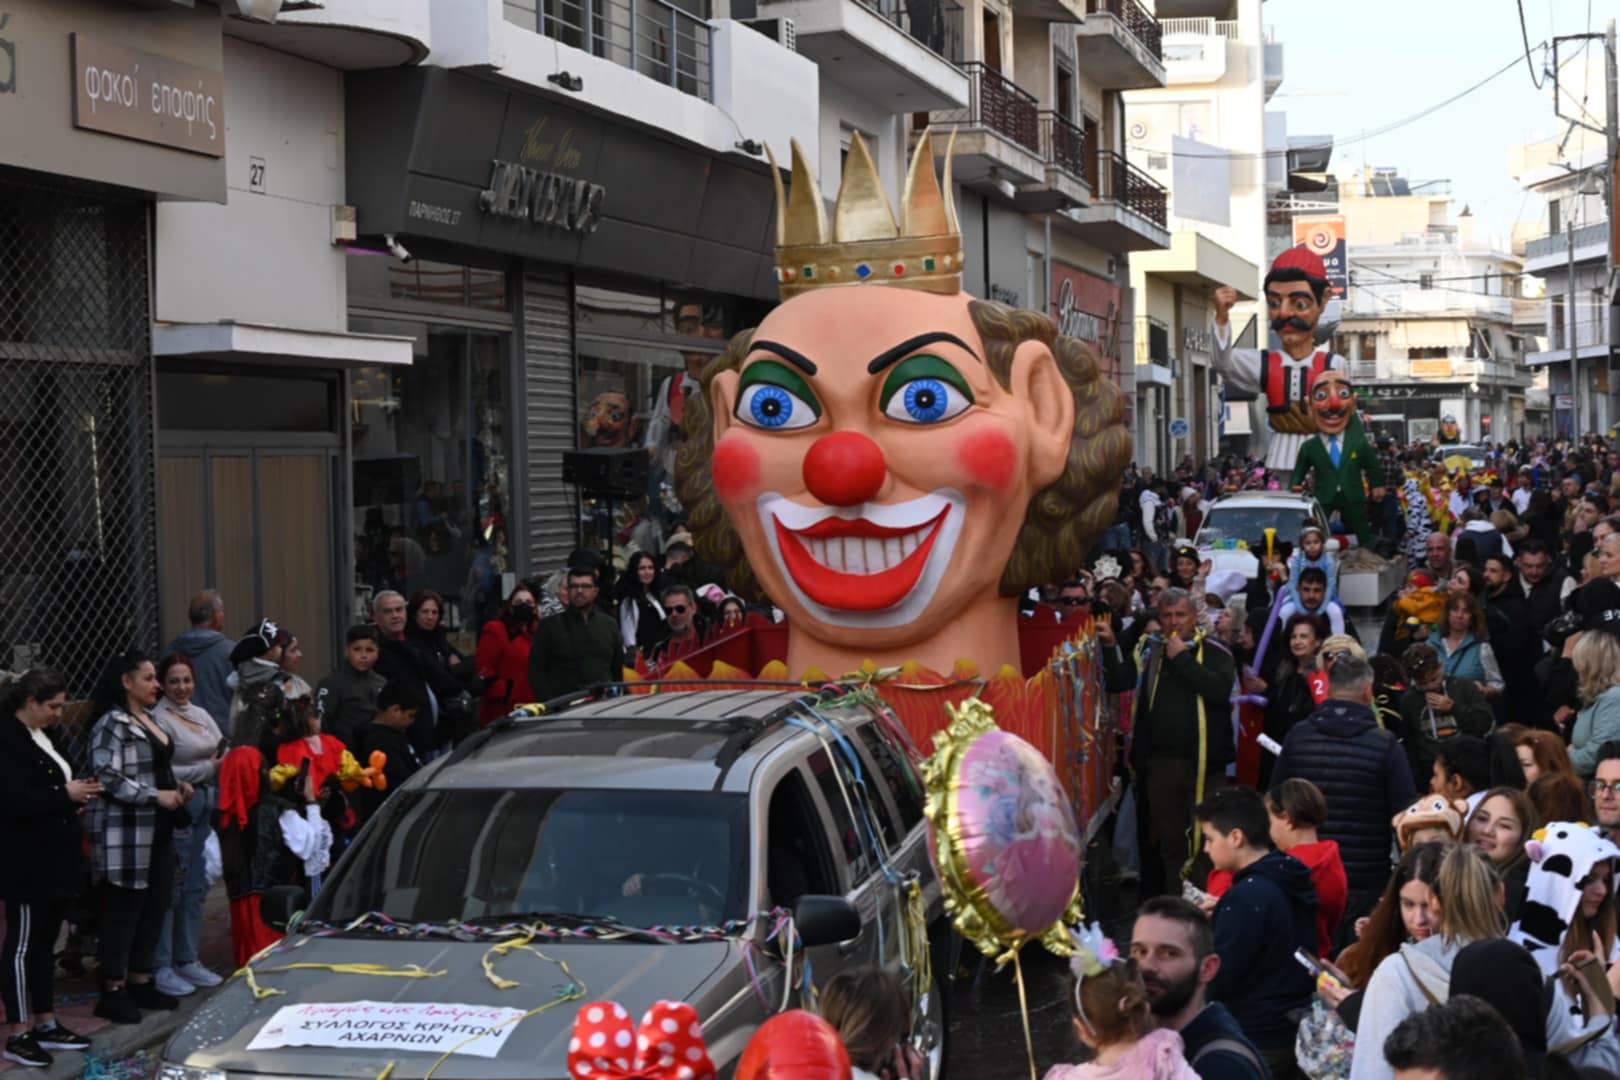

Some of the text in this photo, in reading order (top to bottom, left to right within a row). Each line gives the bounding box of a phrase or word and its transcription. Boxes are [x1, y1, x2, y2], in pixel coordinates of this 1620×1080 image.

[85, 63, 216, 140] φακοί επαφής
[251, 164, 265, 187] 27
[1313, 679, 1325, 695] 2
[300, 1019, 503, 1038] ΣΥΛΛΟΓΟΣ ΚΡΗΤΩΝ
[338, 1031, 443, 1044] ΑΧΑΡΝΩΝ
